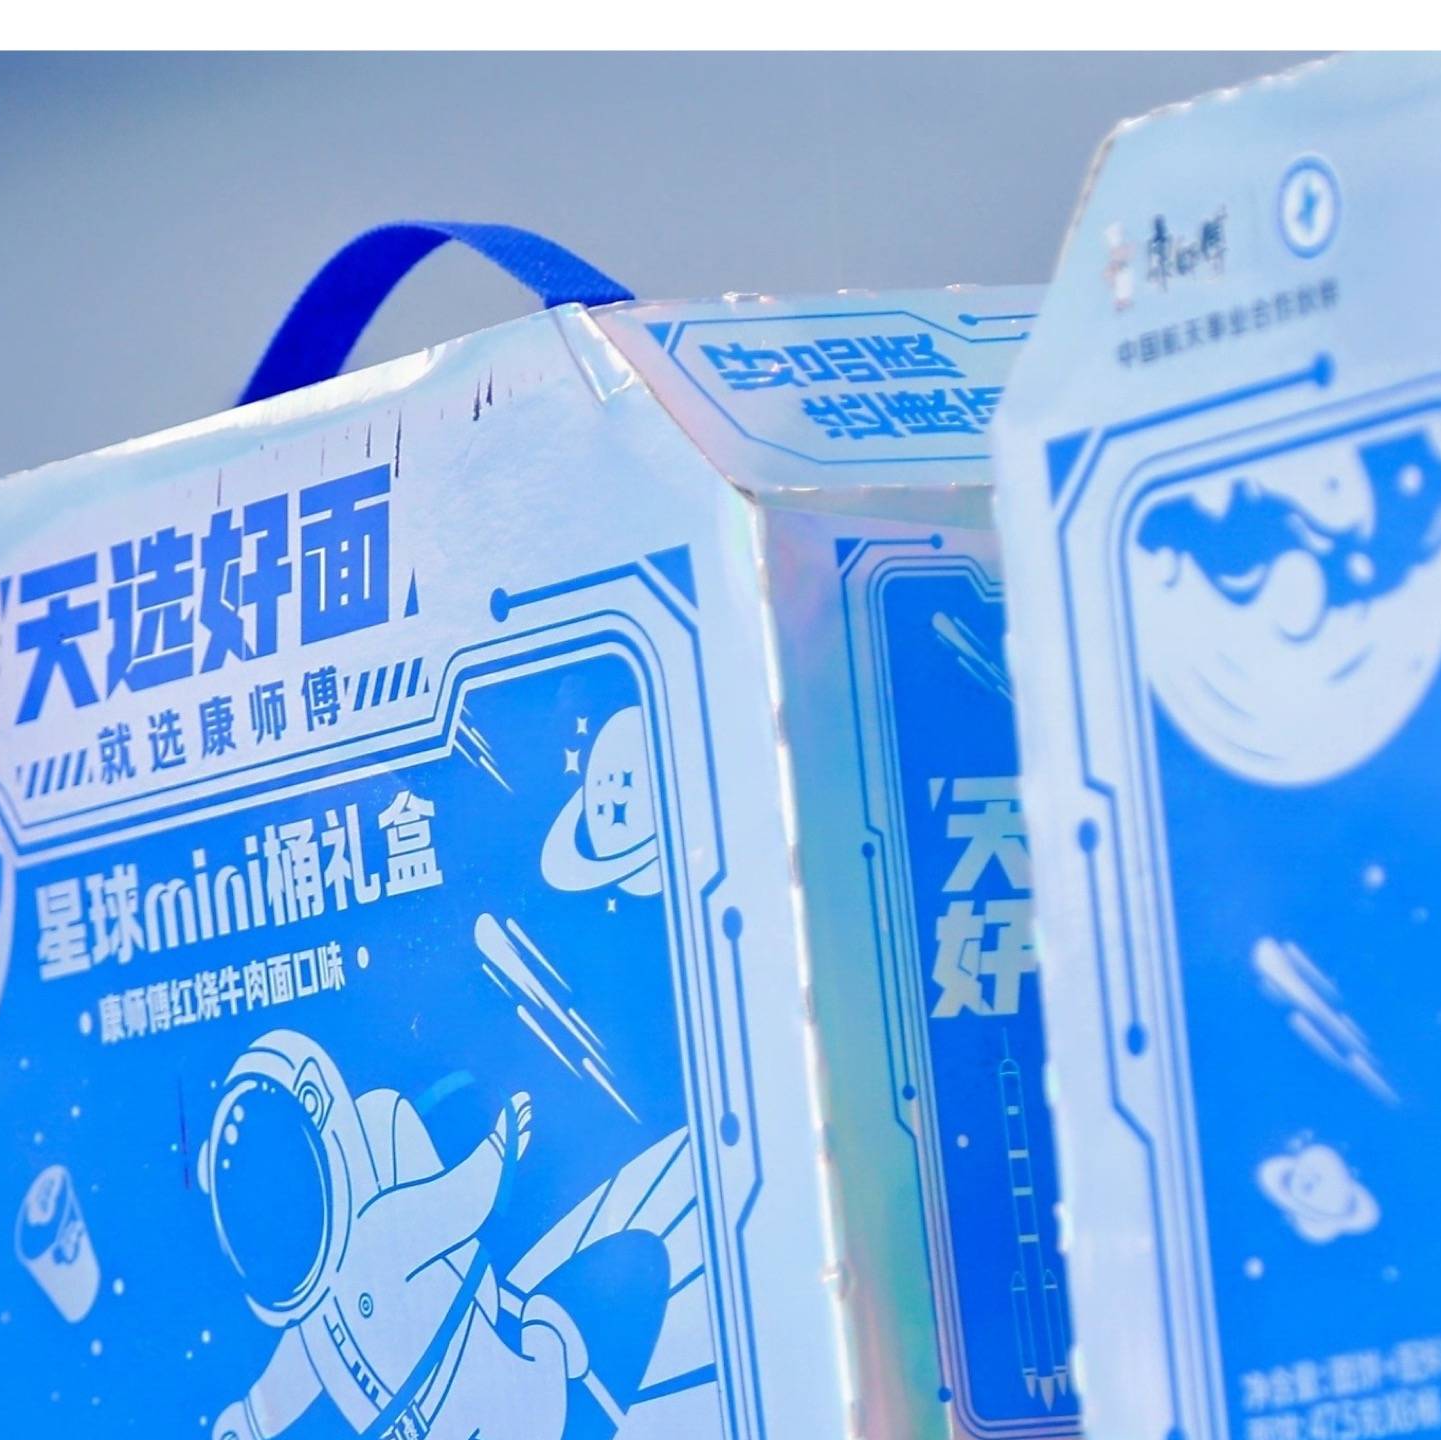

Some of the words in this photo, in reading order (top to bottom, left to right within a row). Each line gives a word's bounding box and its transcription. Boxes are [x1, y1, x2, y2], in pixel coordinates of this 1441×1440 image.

[15, 464, 391, 725] 天选好面
[96, 666, 341, 784] 就选康师傅
[36, 792, 443, 981] 星球mini桶礼盒
[99, 942, 345, 1044] 康师傅红烧牛肉面口味
